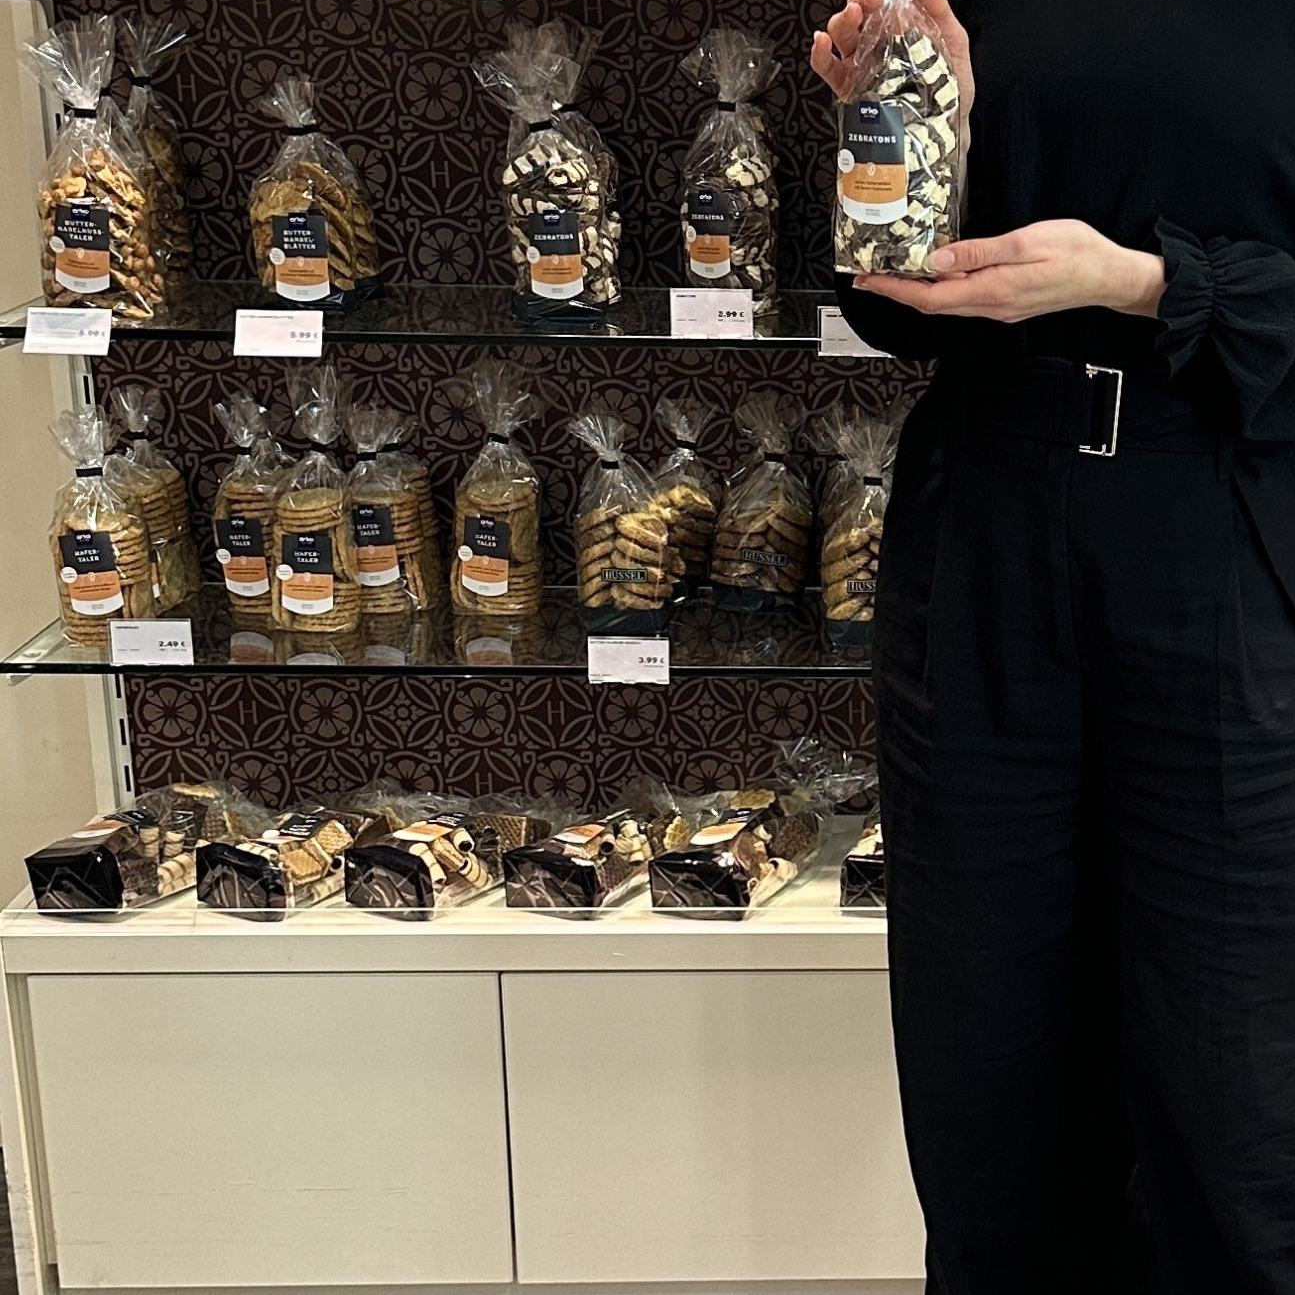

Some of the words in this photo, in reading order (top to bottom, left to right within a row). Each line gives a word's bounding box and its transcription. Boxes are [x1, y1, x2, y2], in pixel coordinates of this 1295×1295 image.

[860, 106, 879, 115] arko
[848, 133, 897, 144] ZEBRATONS
[745, 551, 784, 565] HUSSEL
[603, 570, 645, 581] HUSSEL
